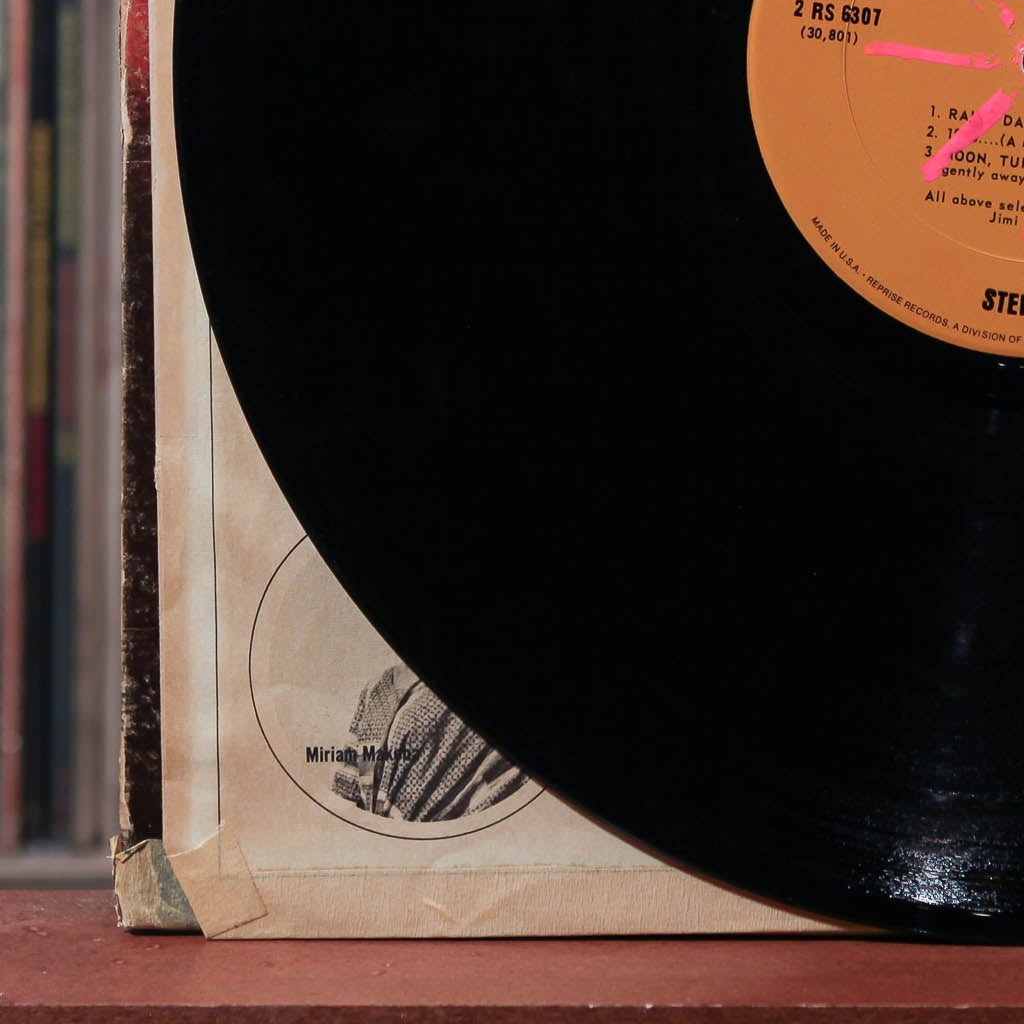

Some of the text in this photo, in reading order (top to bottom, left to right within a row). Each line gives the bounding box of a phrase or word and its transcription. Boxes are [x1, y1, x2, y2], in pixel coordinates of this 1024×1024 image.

[793, 0, 882, 26] 2 RS 6307
[801, 25, 859, 46] (30,801)
[930, 105, 941, 119] 1.
[926, 125, 938, 139] 2.
[949, 150, 991, 168] OON,
[942, 166, 985, 181] gently
[925, 190, 946, 203] All
[952, 194, 993, 209] above
[989, 212, 1018, 226] Jimi
[811, 216, 833, 243] MADE
[830, 242, 841, 254] IN
[866, 276, 904, 305] REPRISE
[952, 323, 960, 331] A
[961, 325, 1006, 343] DIVISION
[1009, 335, 1023, 344] OF
[305, 746, 358, 763] Miriam
